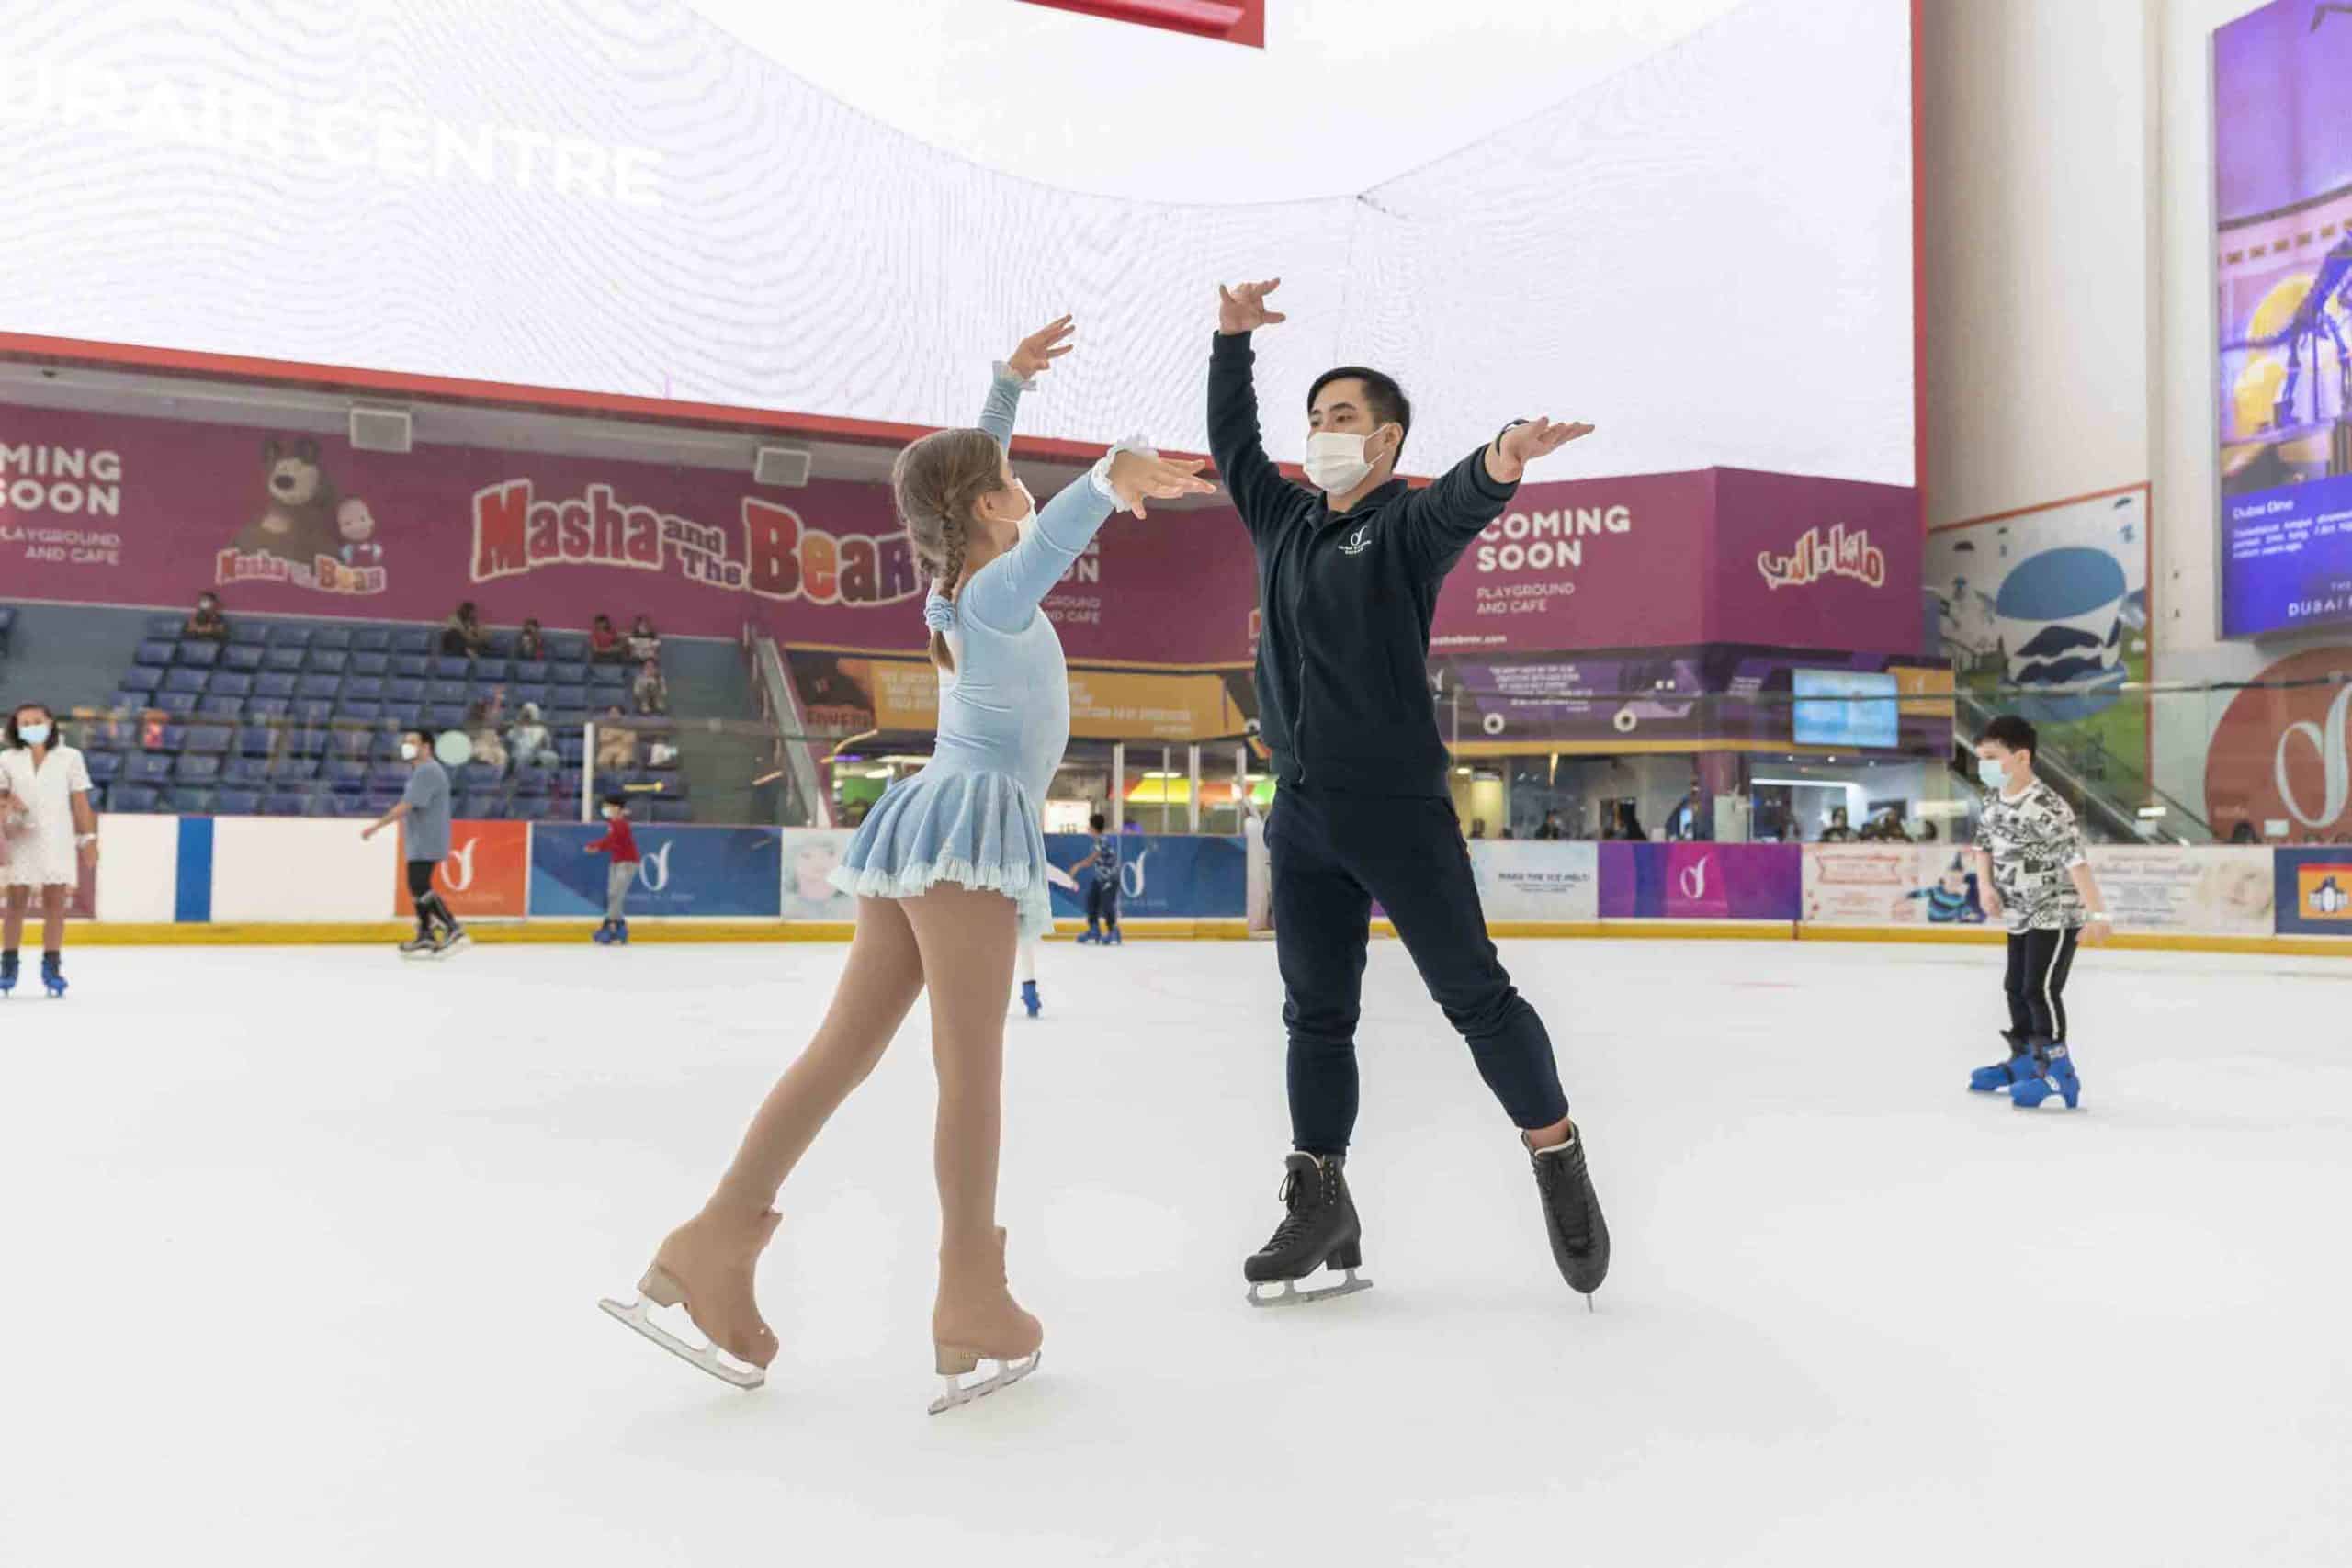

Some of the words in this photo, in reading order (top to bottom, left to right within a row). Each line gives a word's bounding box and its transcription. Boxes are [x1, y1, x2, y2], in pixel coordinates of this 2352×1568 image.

[0, 61, 289, 158] URAIR
[315, 105, 662, 207] CENTRE
[0, 443, 121, 481] MING
[0, 476, 120, 516] OON
[470, 478, 664, 583] Masha
[662, 515, 726, 558] and
[1478, 505, 1632, 542] COMING
[0, 525, 120, 548] LAYGROUND
[25, 546, 66, 561] AND
[70, 547, 119, 566] CAFE
[1477, 539, 1581, 572] SOON
[1043, 592, 1101, 609] GROUND
[1476, 582, 1576, 599] PLAYGROUND
[1046, 609, 1064, 622] ND
[1476, 601, 1508, 615] AND
[1510, 598, 1548, 612] CAFE
[2288, 595, 2344, 618] DUBAI
[1498, 873, 1524, 881] MAKE
[1527, 873, 1544, 881] THE
